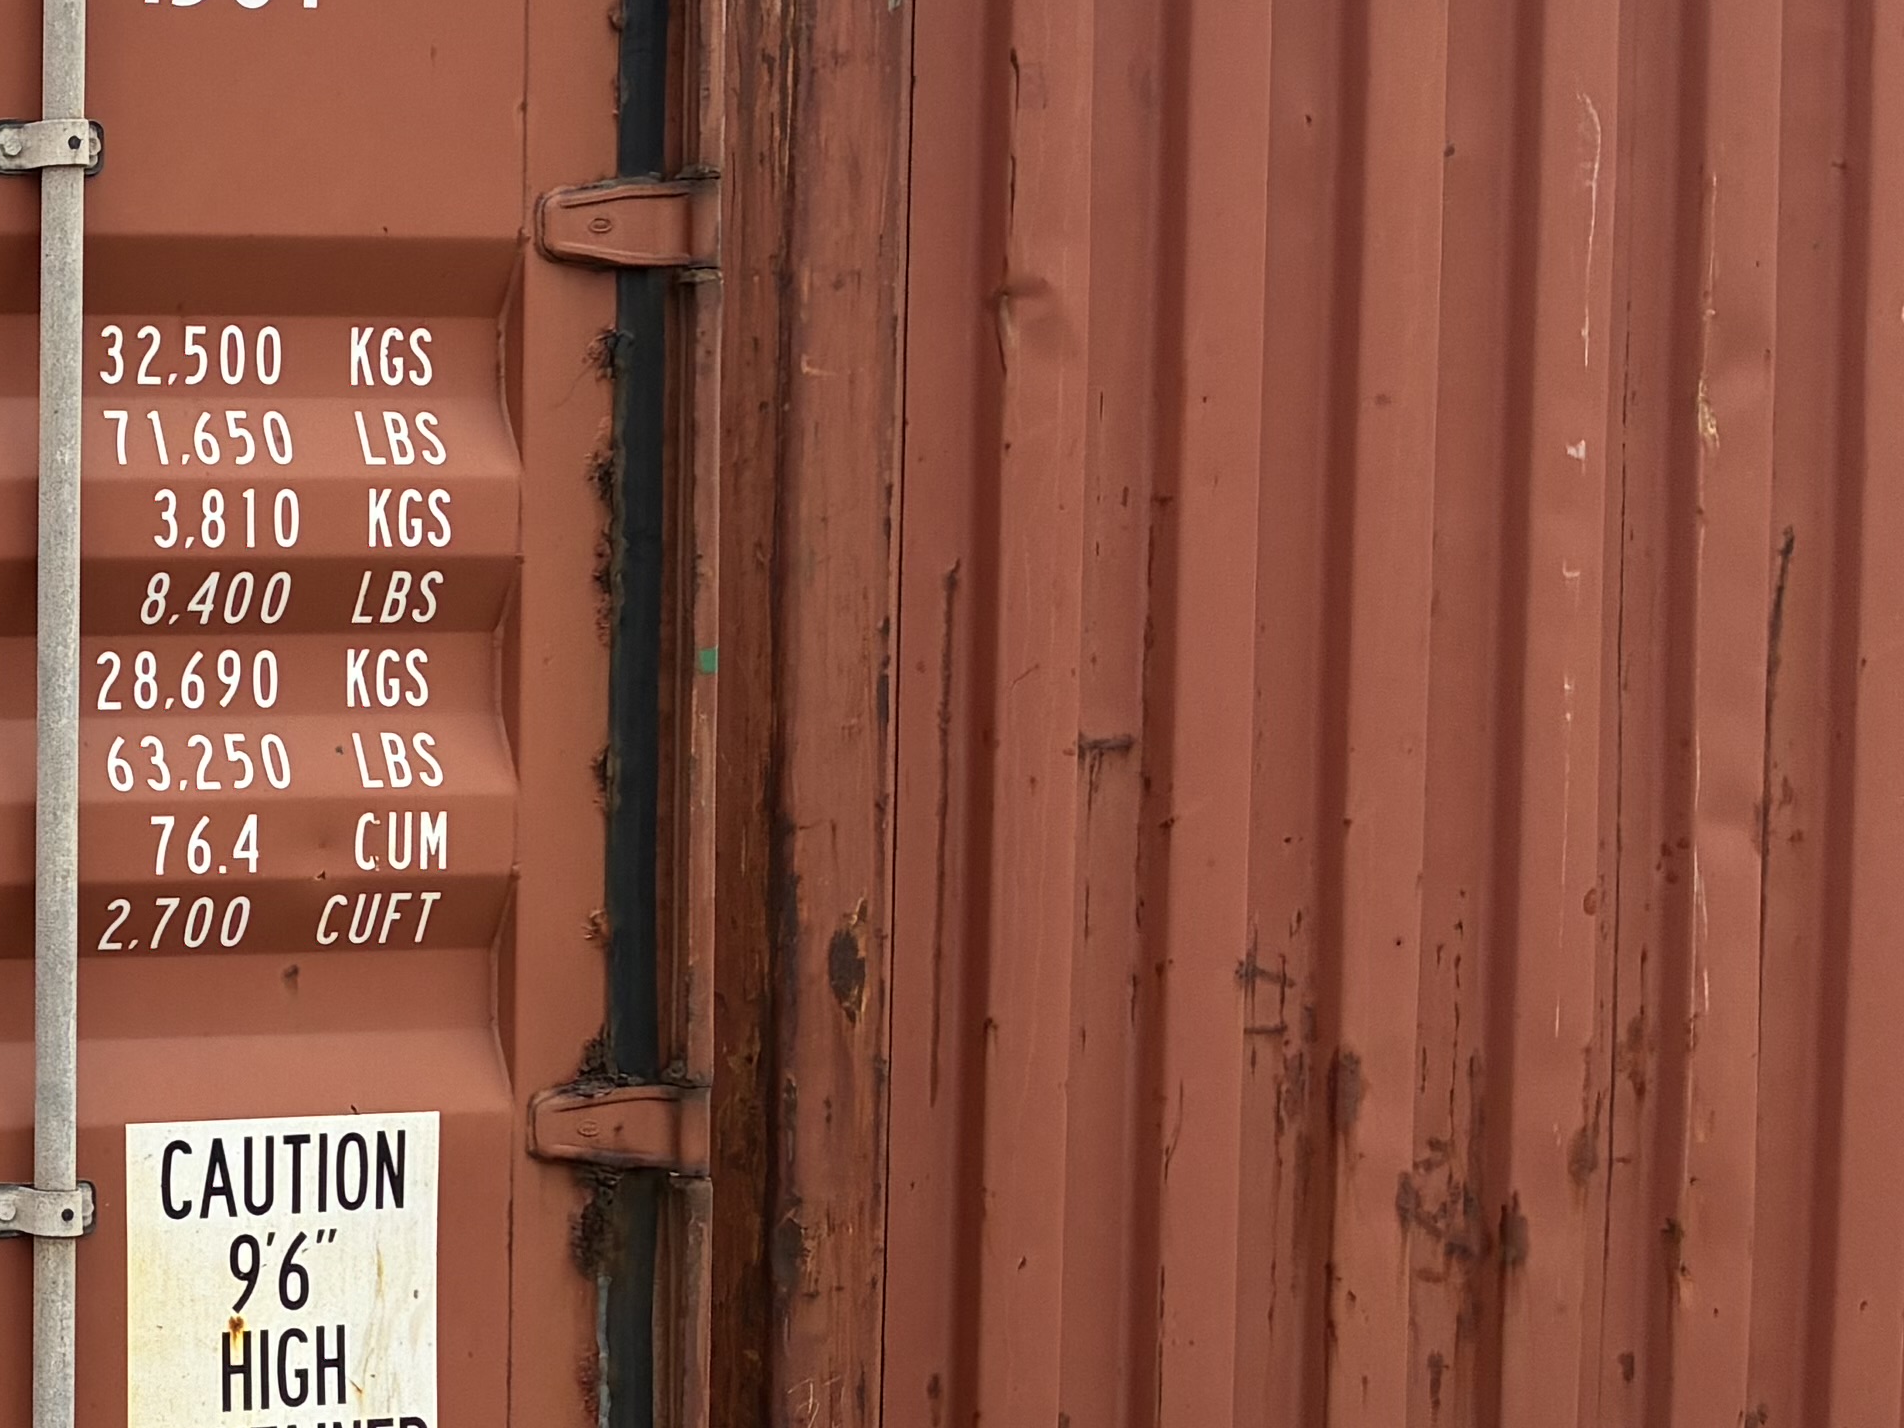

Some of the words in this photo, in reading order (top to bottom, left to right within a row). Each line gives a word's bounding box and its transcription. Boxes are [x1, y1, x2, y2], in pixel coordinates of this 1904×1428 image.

[351, 327, 432, 386] KGS
[355, 412, 446, 465] LBS
[369, 489, 451, 547] KGS
[352, 571, 443, 623] LBS
[347, 649, 428, 707] KGS
[353, 733, 443, 788] LBS
[151, 815, 258, 875] 76.4
[355, 812, 447, 870] CUM
[317, 893, 441, 944] CUFT
[161, 1130, 405, 1219] CAUTION
[222, 1325, 346, 1412] HIGH
